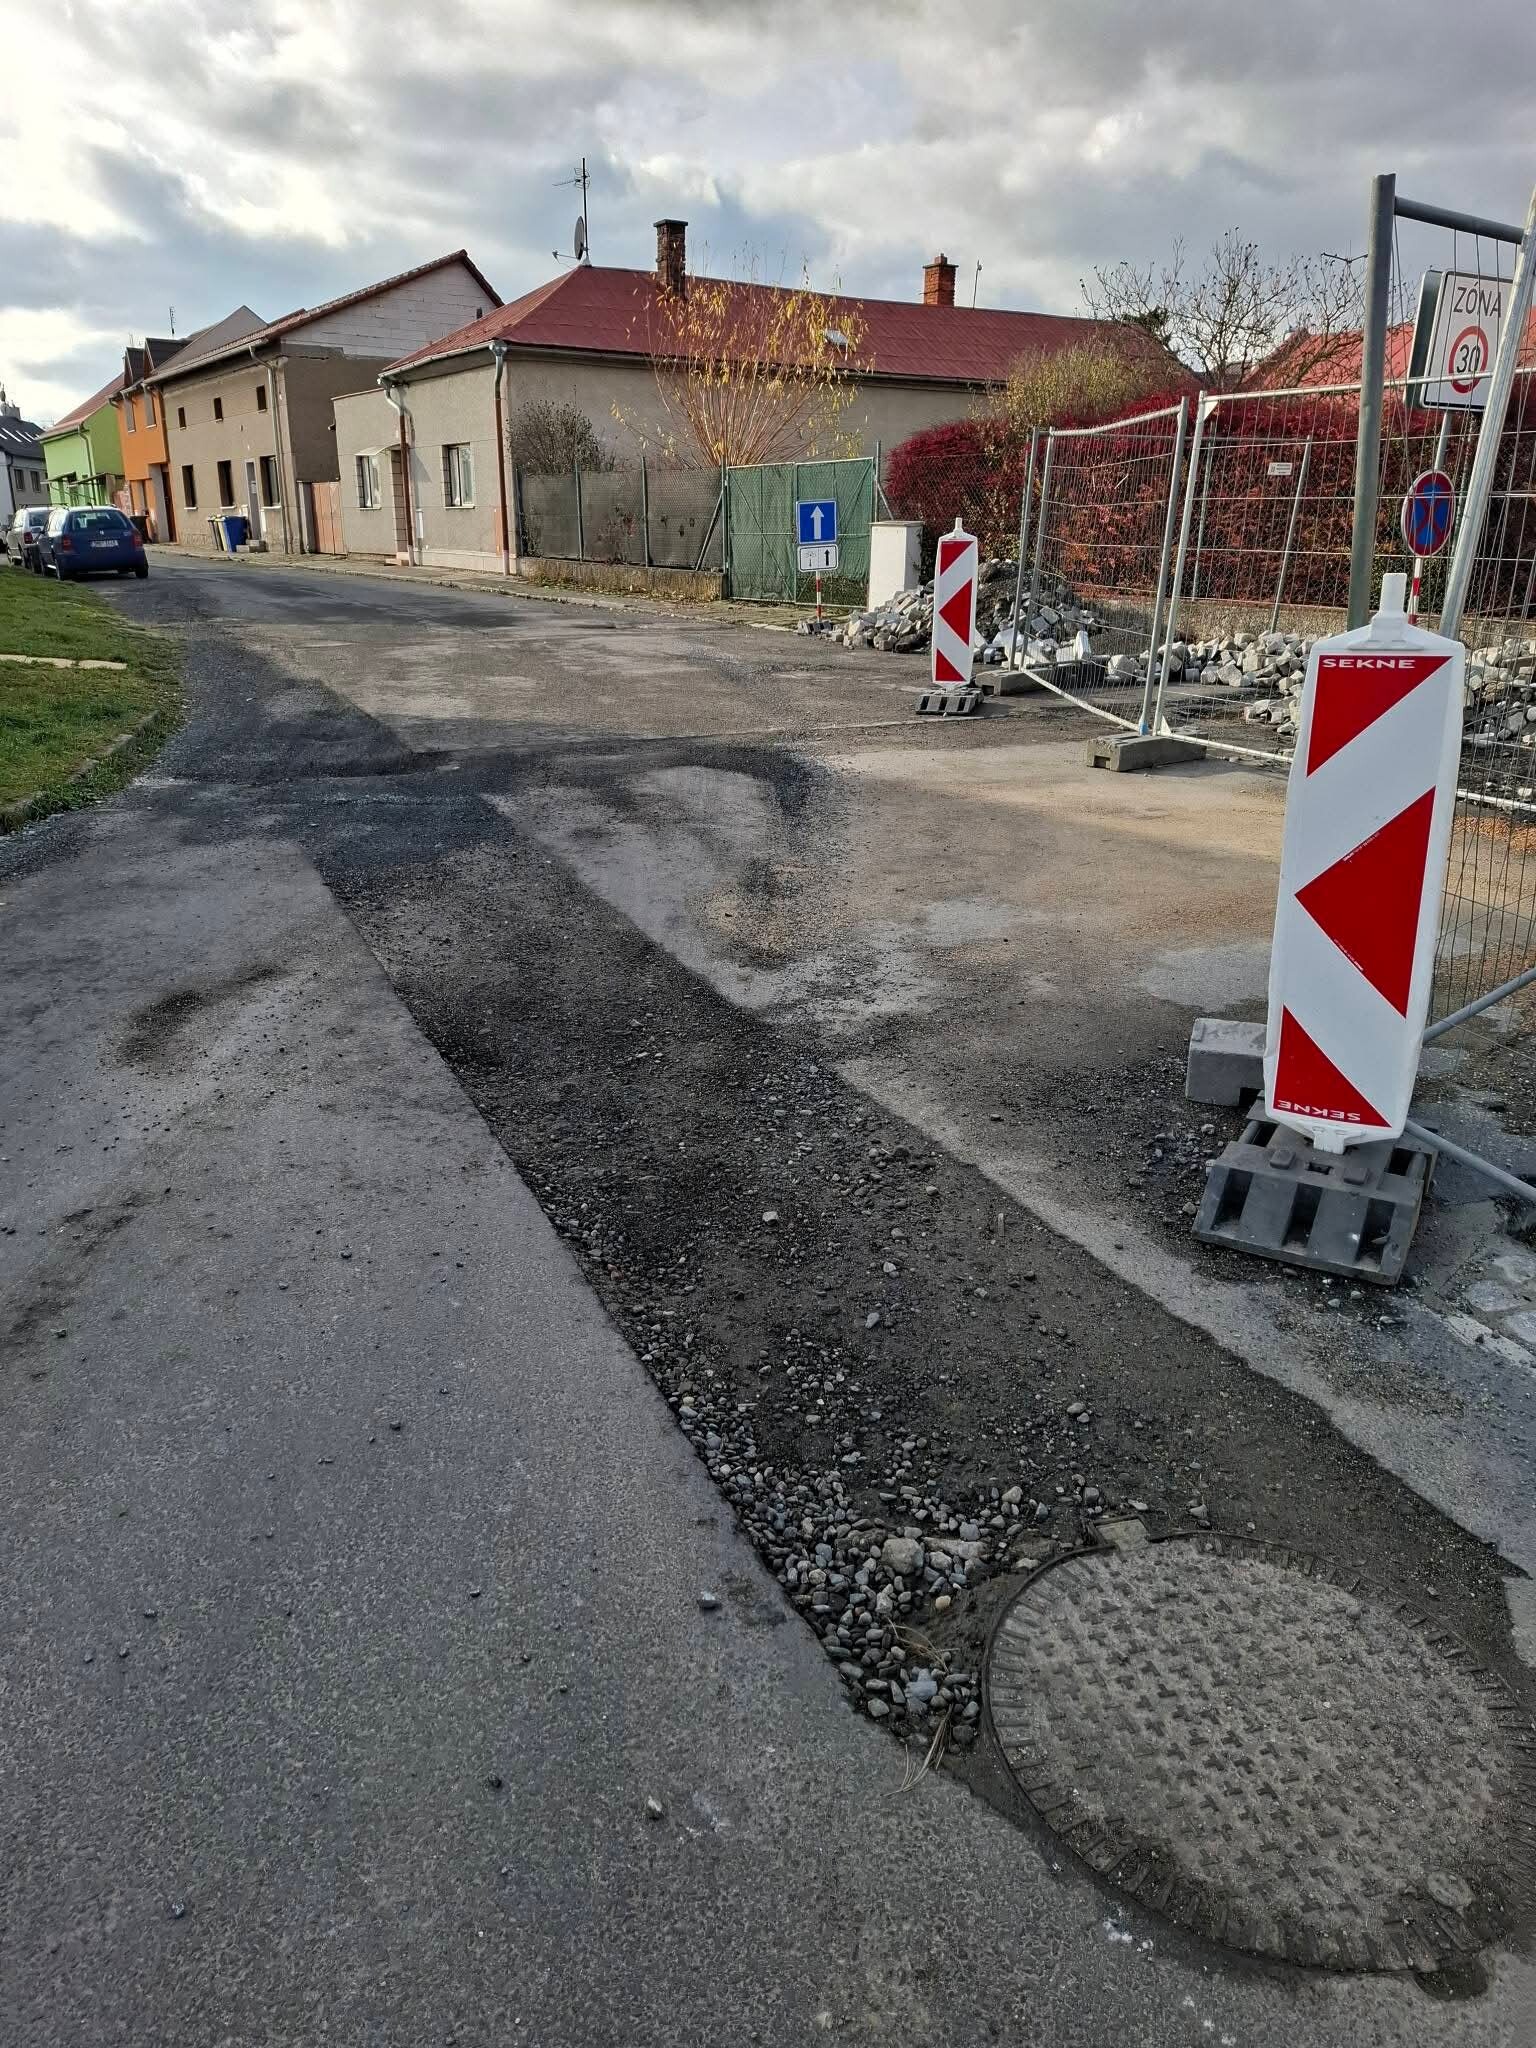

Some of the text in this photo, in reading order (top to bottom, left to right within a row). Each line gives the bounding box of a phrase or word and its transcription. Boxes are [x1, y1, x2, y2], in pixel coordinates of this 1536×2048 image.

[1453, 282, 1502, 318] ZÓNA
[1456, 344, 1481, 373] 30
[1322, 658, 1416, 669] SEKNE
[1278, 1099, 1361, 1121] SEKNE
